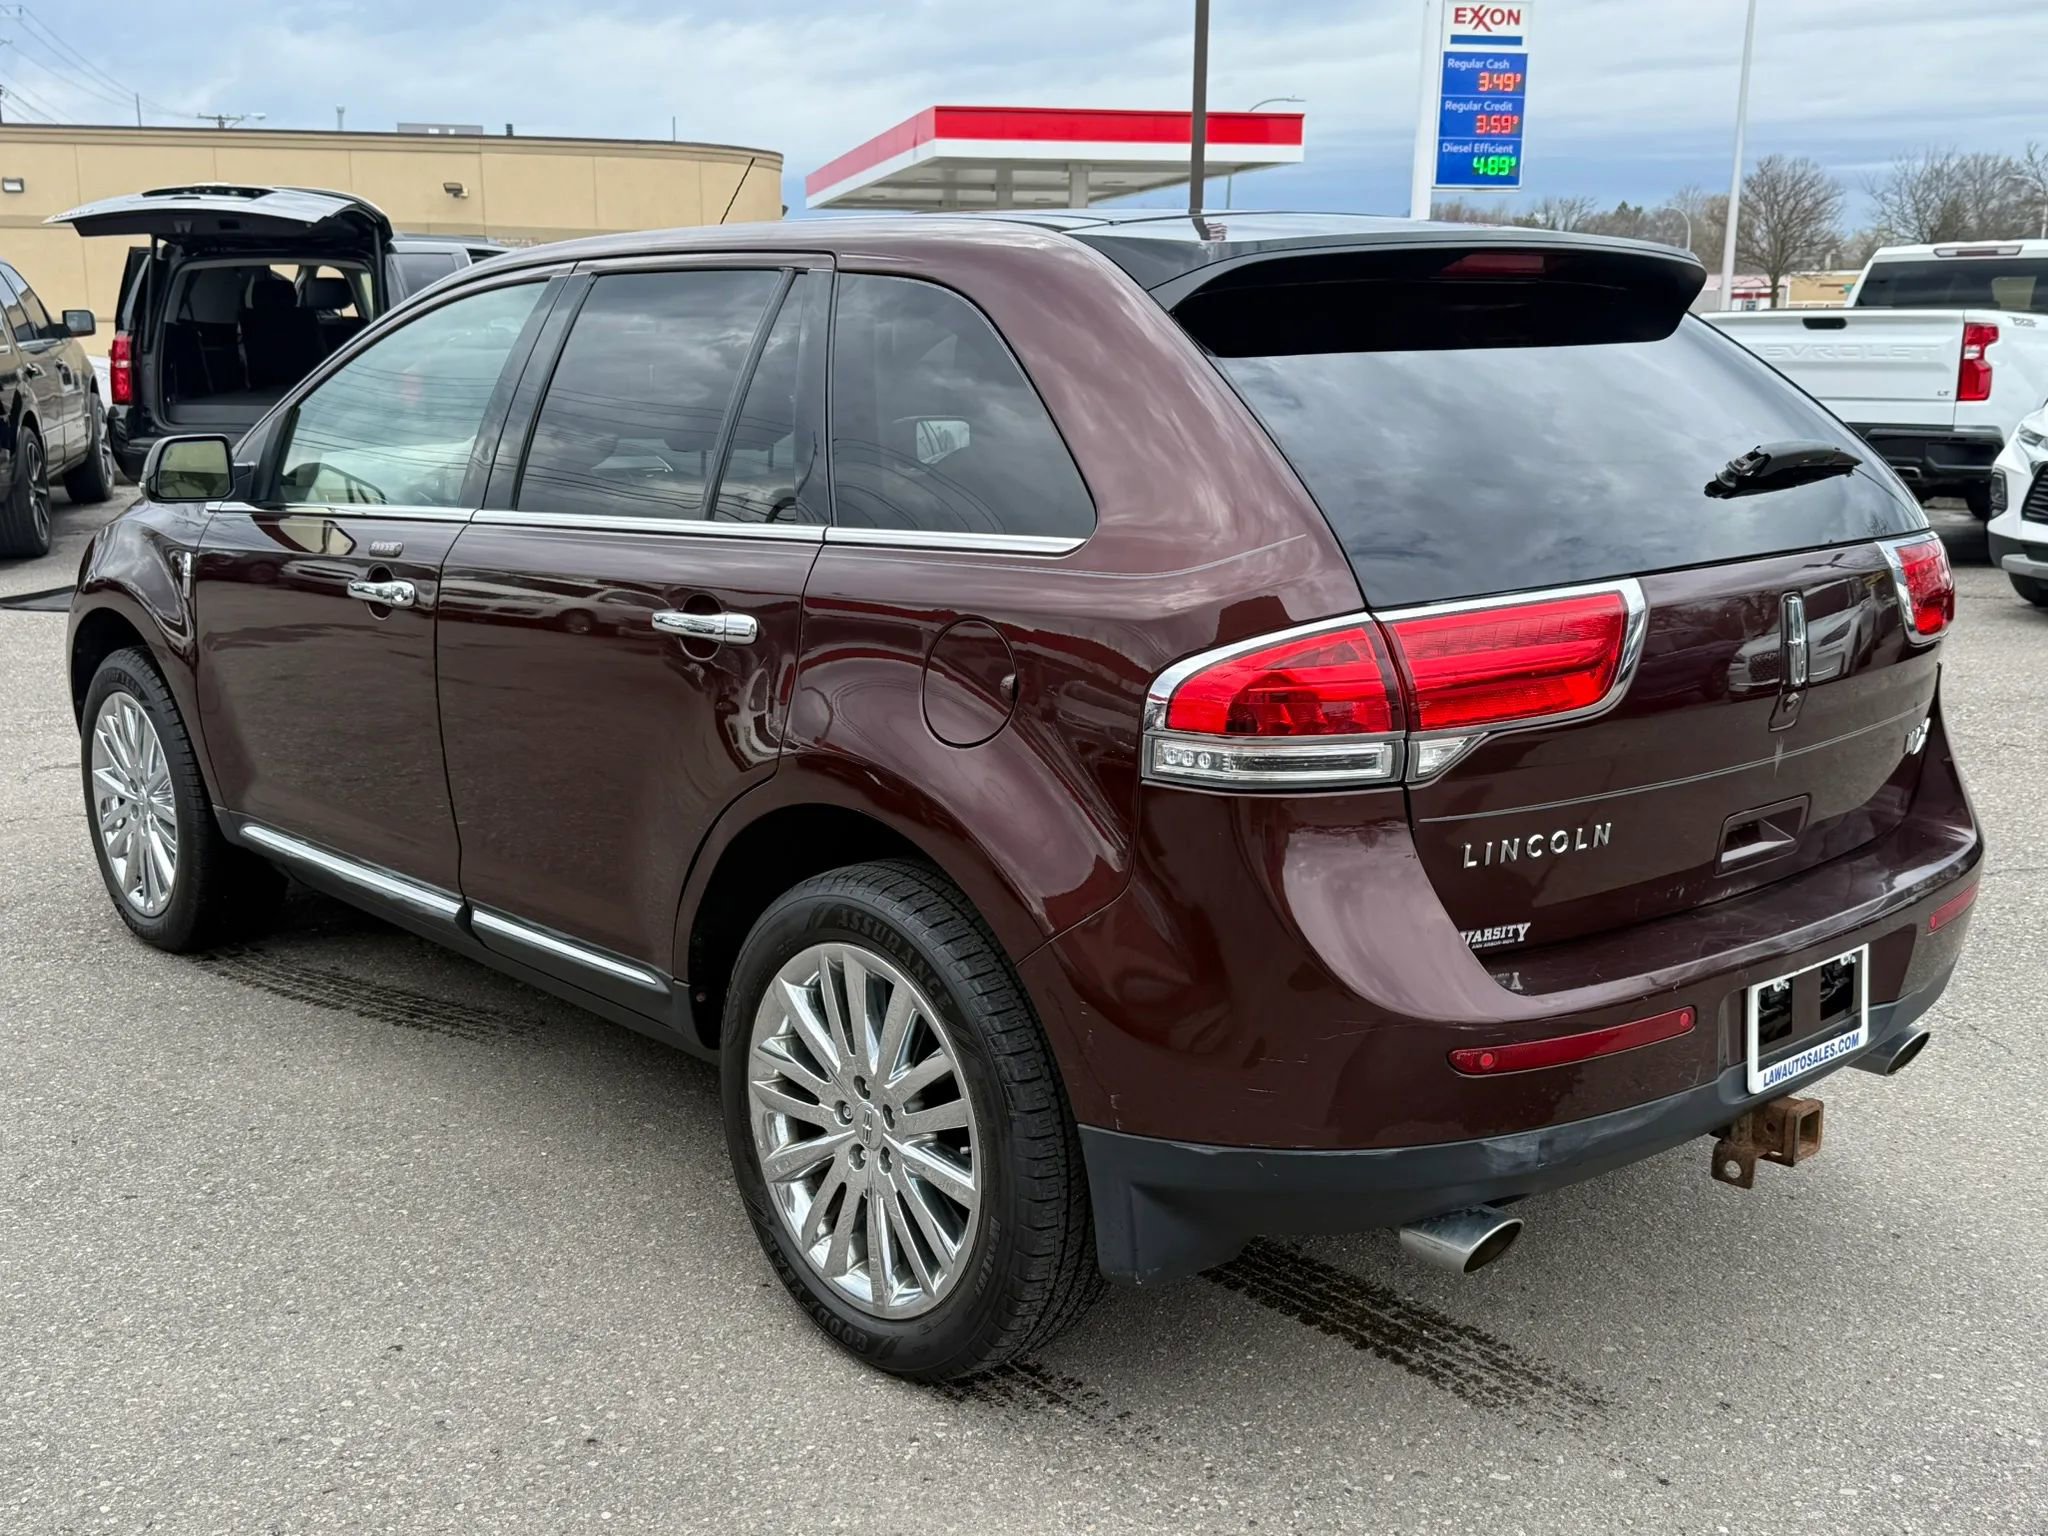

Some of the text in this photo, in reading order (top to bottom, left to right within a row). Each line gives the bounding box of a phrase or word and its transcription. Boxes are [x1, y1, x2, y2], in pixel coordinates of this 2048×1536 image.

[1453, 4, 1521, 32] EXXON
[1447, 58, 1510, 71] Regular Cash
[1444, 100, 1513, 113] Regular Credit
[1442, 143, 1513, 153] Diesel Efficient
[1757, 344, 1940, 359] EVROLET
[1462, 822, 1612, 869] LINCOLN
[1460, 921, 1532, 945] VARSITY
[1763, 1032, 1860, 1088] LAWAUTOSALES.COM
